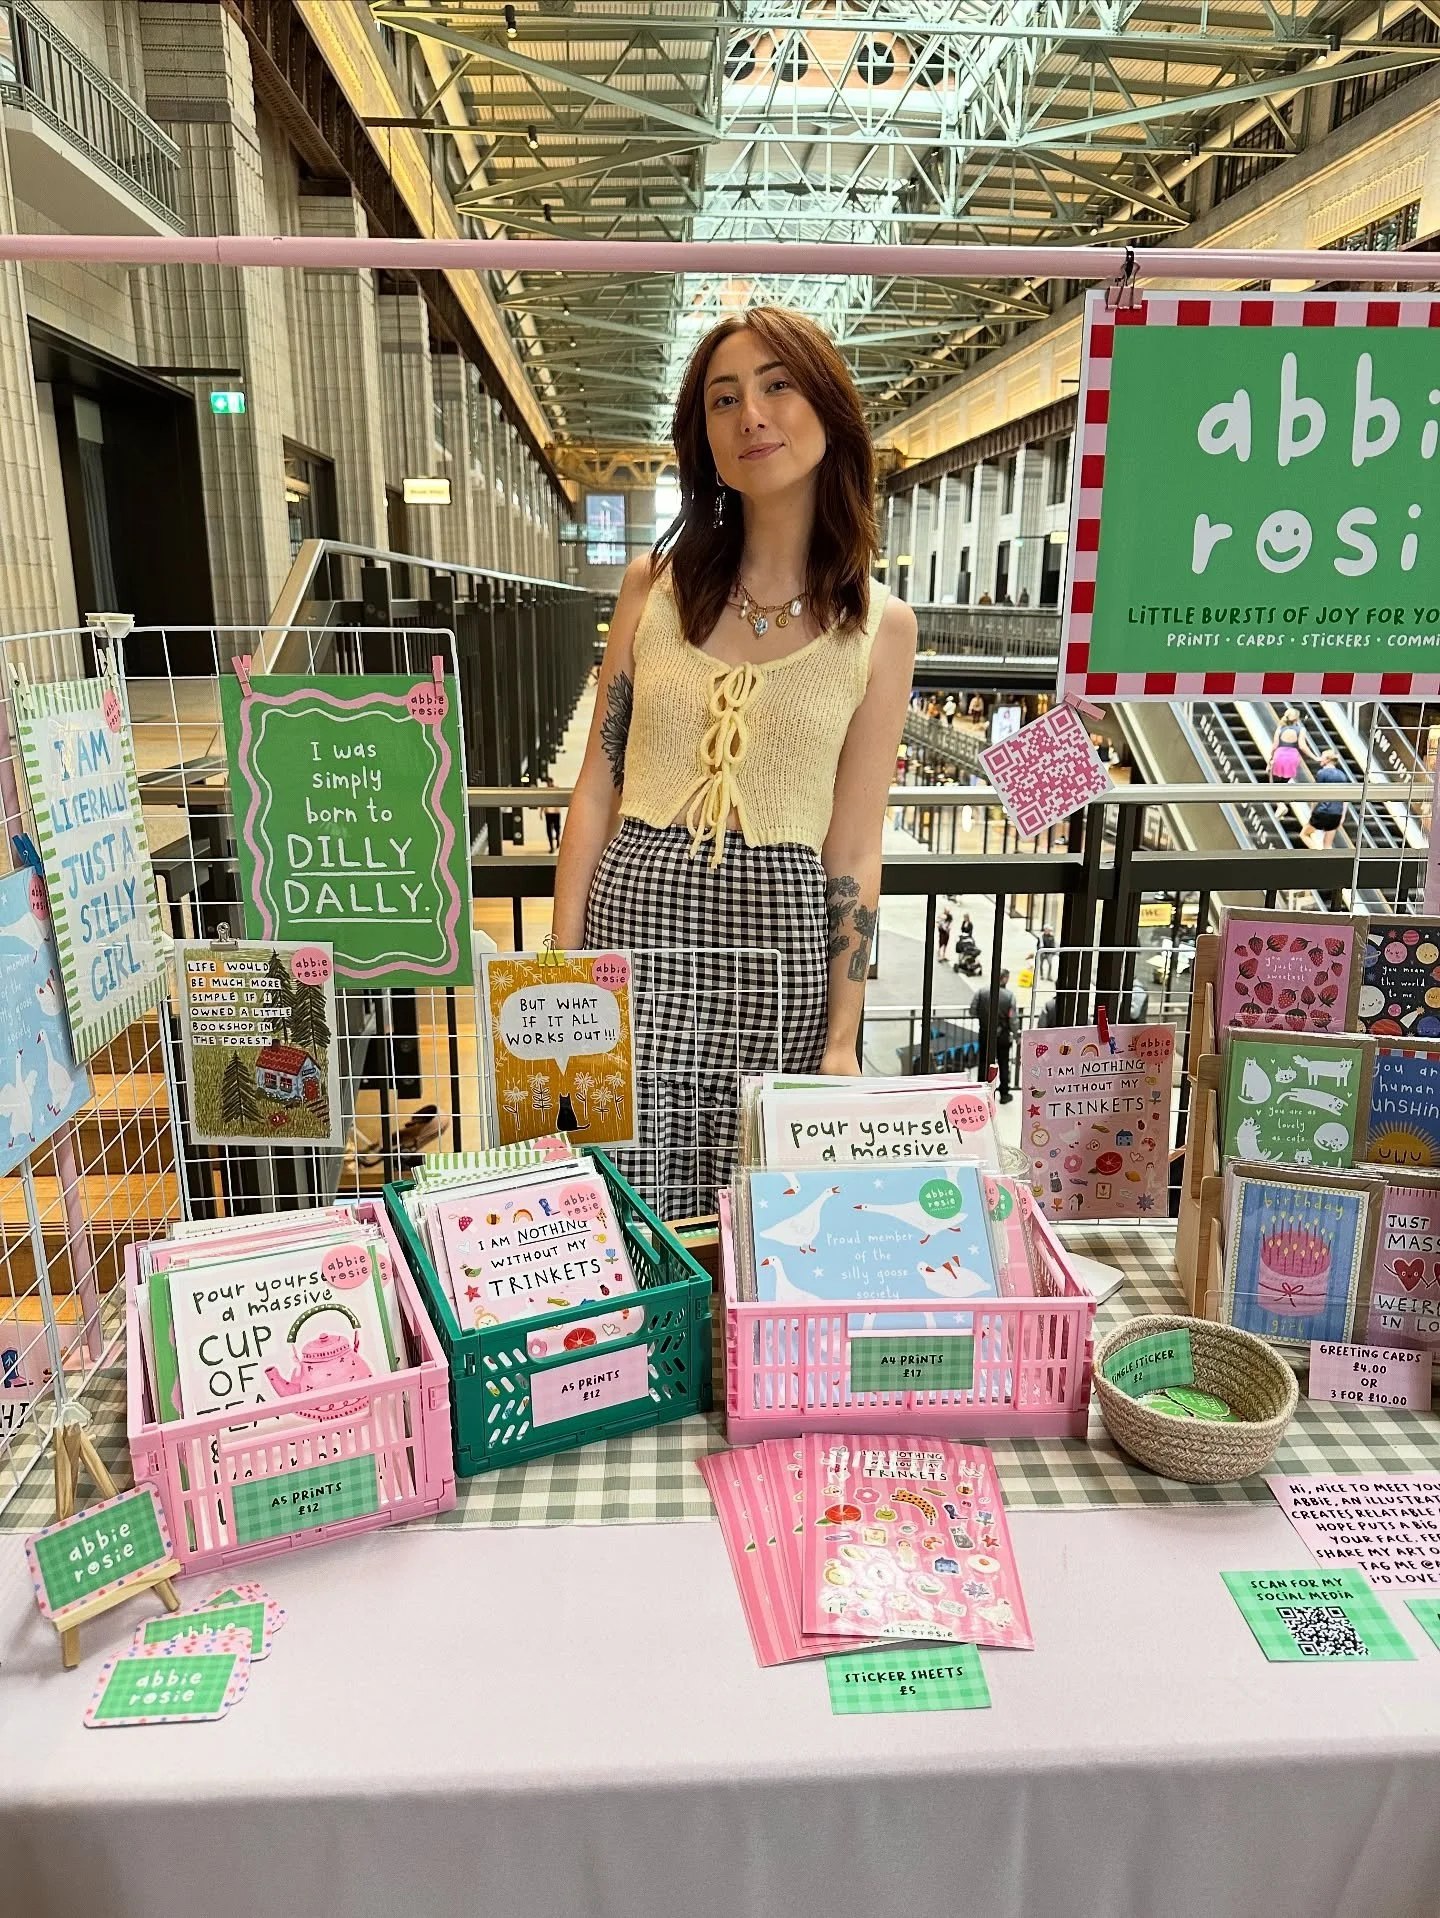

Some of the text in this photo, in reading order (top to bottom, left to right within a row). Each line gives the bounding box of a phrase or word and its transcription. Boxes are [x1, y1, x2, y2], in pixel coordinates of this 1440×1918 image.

[1202, 607, 1276, 625] BURSTS
[1283, 606, 1309, 623] OF
[1316, 607, 1358, 625] JOY
[1367, 607, 1405, 625] FOR
[1237, 633, 1284, 647] CARDS
[411, 695, 444, 705] abbie
[412, 706, 444, 716] rosie
[54, 728, 111, 782] I AM
[310, 742, 377, 761] I was
[312, 766, 382, 799] simply
[50, 777, 128, 834] LITERALLY
[306, 797, 393, 824] born to
[288, 834, 412, 869] DILLY
[62, 826, 137, 899] JUST A
[284, 880, 430, 914] DALLY.
[80, 876, 136, 944] SILLY
[188, 962, 269, 972] LIFE WOULD
[296, 957, 328, 968] abbie
[596, 961, 627, 973] abbie
[297, 969, 329, 978] rosie
[596, 974, 626, 983] rosie
[191, 978, 280, 988] BE MUCH MORE
[192, 993, 256, 1001] SIMPLE IF
[520, 998, 598, 1011] BUT WHAT
[191, 1008, 291, 1016] OWNED A LITTLE
[192, 1022, 272, 1031] BOOKSHOP IN
[522, 1013, 598, 1028] IF IT ALL
[193, 1036, 271, 1045] THE FOREST.
[506, 1032, 564, 1046] WORKS
[1141, 1037, 1171, 1048] abbie
[1140, 1047, 1170, 1057] rosie
[1058, 1059, 1145, 1076] AM NOTHING
[1372, 1062, 1403, 1078] you
[1054, 1078, 1139, 1094] WITHOUT MY
[1380, 1075, 1434, 1094] human
[951, 1103, 983, 1115] abbie
[1048, 1097, 1144, 1117] TRINKETS
[954, 1115, 985, 1125] rosie
[1278, 1117, 1304, 1132] lovely
[790, 1119, 849, 1148] pour
[822, 1140, 949, 1161] a massive
[564, 1192, 597, 1206] abbie
[925, 1187, 954, 1198] abbie
[567, 1201, 599, 1216] rosie
[927, 1198, 956, 1208] rosie
[1264, 1190, 1344, 1220] birthday
[1387, 1214, 1430, 1230] JUST
[478, 1240, 485, 1251] I
[491, 1236, 510, 1248] AM
[826, 1230, 913, 1246] Proud member
[491, 1238, 586, 1269] WITHOUT MY
[873, 1247, 891, 1261] the
[327, 1254, 367, 1271] abbie
[330, 1265, 368, 1282] rosie
[488, 1259, 601, 1296] TRINKETS
[841, 1265, 908, 1285] silly goose
[192, 1269, 327, 1314] pour yourse
[222, 1287, 333, 1322] a massive
[1382, 1315, 1402, 1329] IN
[198, 1325, 272, 1366] CUP
[881, 1355, 896, 1365] A4
[1382, 1350, 1421, 1363] CARDS
[903, 1368, 922, 1379] £17
[1352, 1361, 1387, 1374] £4.00
[209, 1362, 258, 1397] OF
[1133, 1371, 1143, 1384] £2
[1361, 1377, 1378, 1388] OR
[582, 1388, 602, 1401] £12
[1330, 1389, 1407, 1406] 3 FOR £10.00
[1349, 1484, 1369, 1492] TO
[1374, 1483, 1410, 1492] MEET
[1342, 1497, 1361, 1505] AN
[298, 1502, 320, 1515] £12
[1291, 1508, 1435, 1519] CREATES RELATABLE
[1316, 1521, 1356, 1531] HOPE
[1358, 1521, 1395, 1531] PUTS
[1400, 1521, 1410, 1529] A
[69, 1523, 131, 1561] abbie
[1330, 1535, 1373, 1544] YOUR
[1316, 1546, 1425, 1558] SHARE MY ART
[73, 1543, 135, 1582] rosie
[1358, 1560, 1417, 1570] TAG ME
[1250, 1577, 1345, 1589] SCAN FOR MY
[1395, 1573, 1437, 1583] LOVE
[135, 1669, 202, 1688] abbie
[911, 1666, 963, 1681] SHEETS
[129, 1689, 195, 1706] rosie
[899, 1685, 916, 1696] £5
